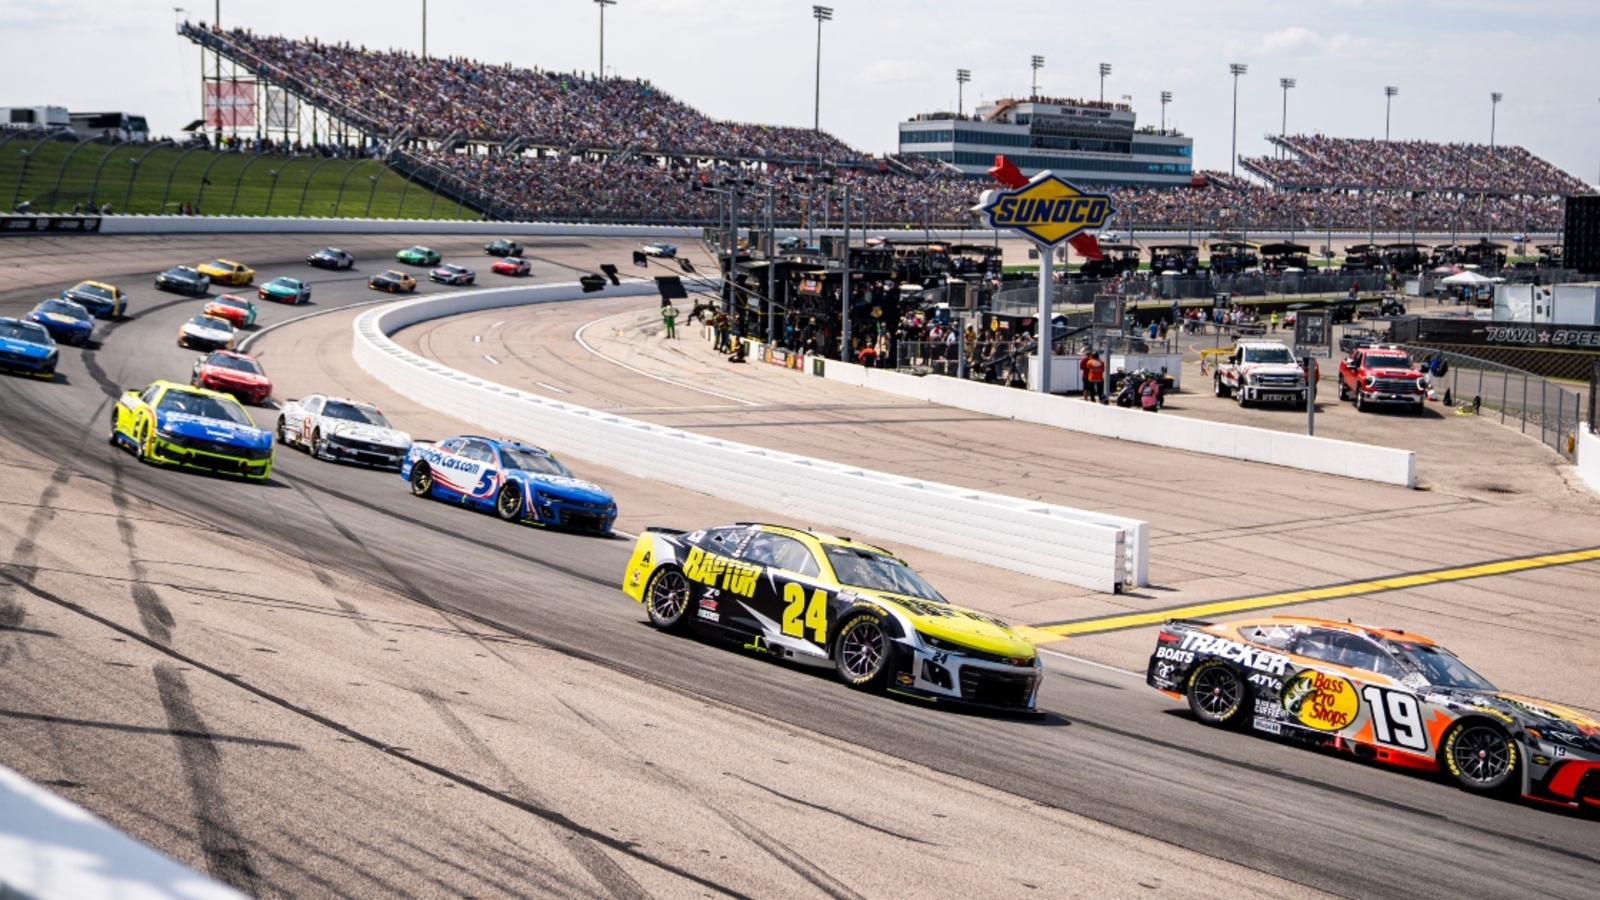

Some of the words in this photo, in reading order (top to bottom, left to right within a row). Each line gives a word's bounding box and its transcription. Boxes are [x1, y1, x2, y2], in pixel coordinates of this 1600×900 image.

[996, 198, 1107, 223] SUNOCO
[1485, 326, 1536, 343] IOWA
[473, 468, 498, 495] 5
[683, 545, 763, 598] RAPTOR
[781, 582, 829, 644] 24
[932, 652, 949, 665] 24
[1156, 646, 1195, 664] BOATS
[1180, 630, 1291, 676] TRACKER
[1247, 673, 1284, 690] ATVs
[1313, 671, 1344, 693] Bass
[1313, 690, 1335, 708] Pro
[1310, 702, 1348, 727] Shops
[1361, 684, 1428, 750] 19
[1445, 724, 1464, 777] GOODYEAR
[1507, 741, 1517, 771] EAGLE
